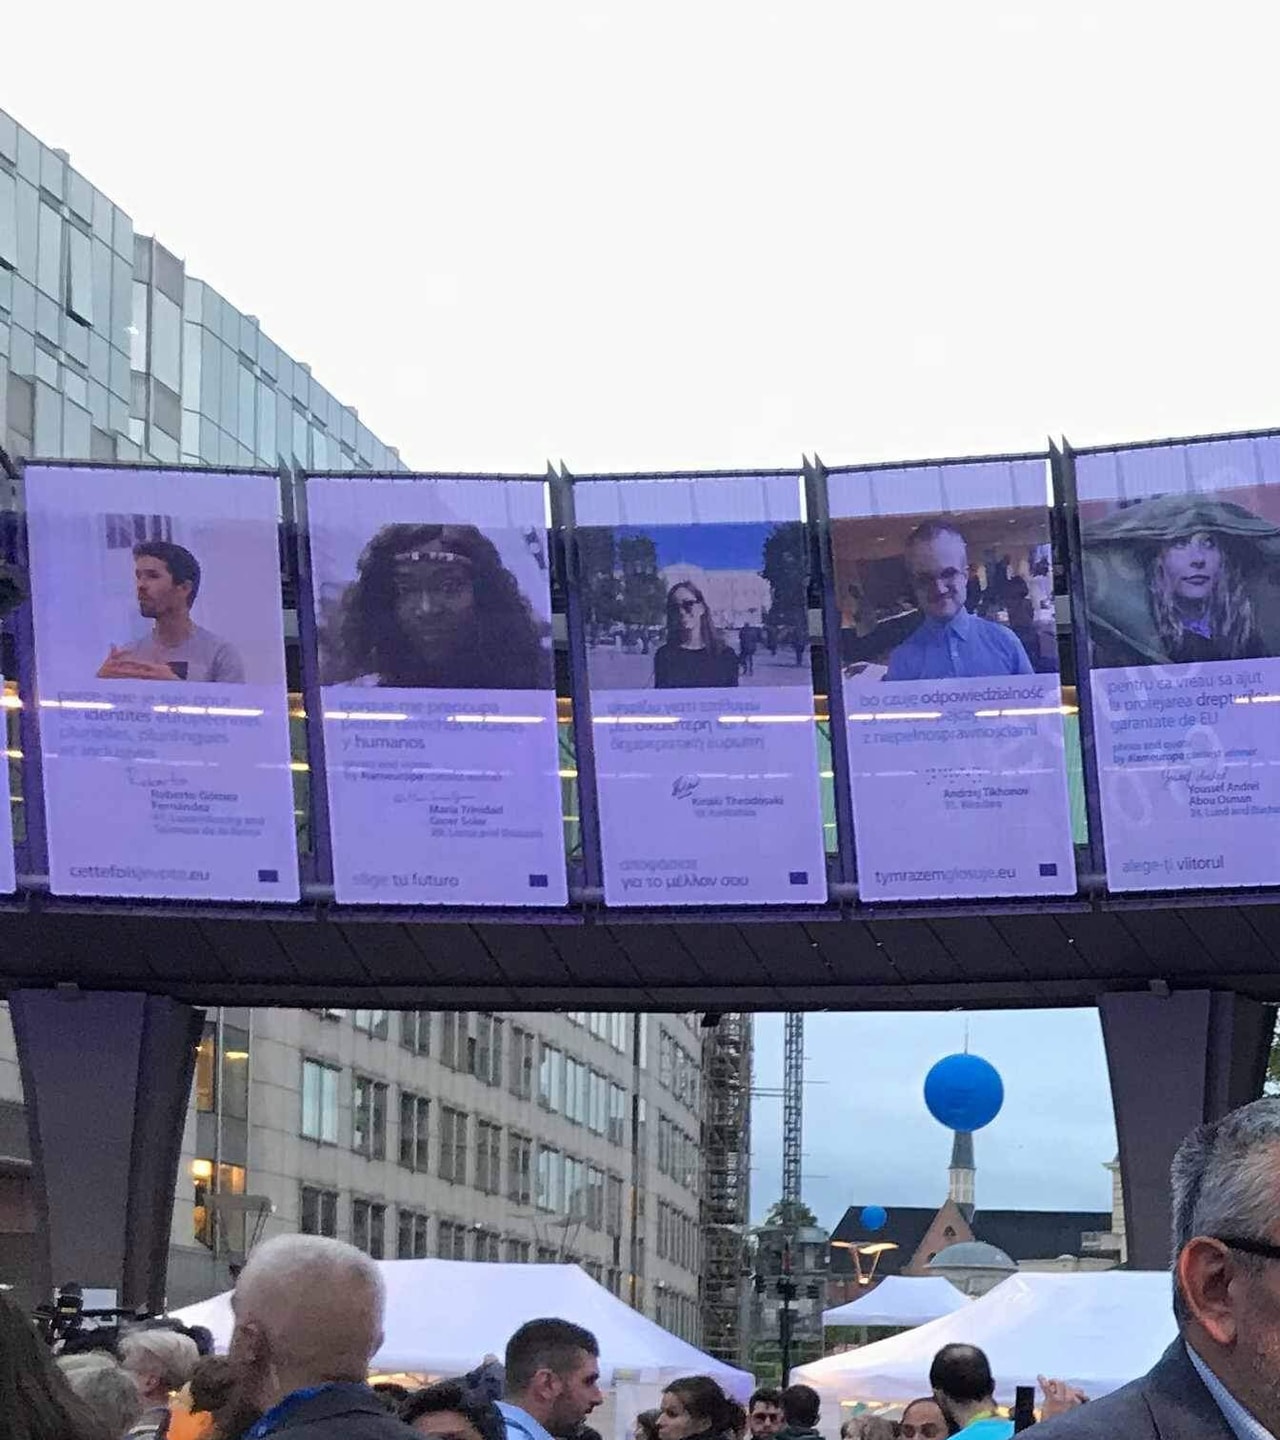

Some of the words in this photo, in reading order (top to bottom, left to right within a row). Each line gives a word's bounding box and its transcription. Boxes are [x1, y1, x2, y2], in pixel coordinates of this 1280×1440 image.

[1236, 671, 1263, 690] ajut
[1179, 713, 1196, 727] de
[355, 734, 426, 750] humanos
[1176, 854, 1225, 871] viitorul
[411, 871, 460, 889] futuro
